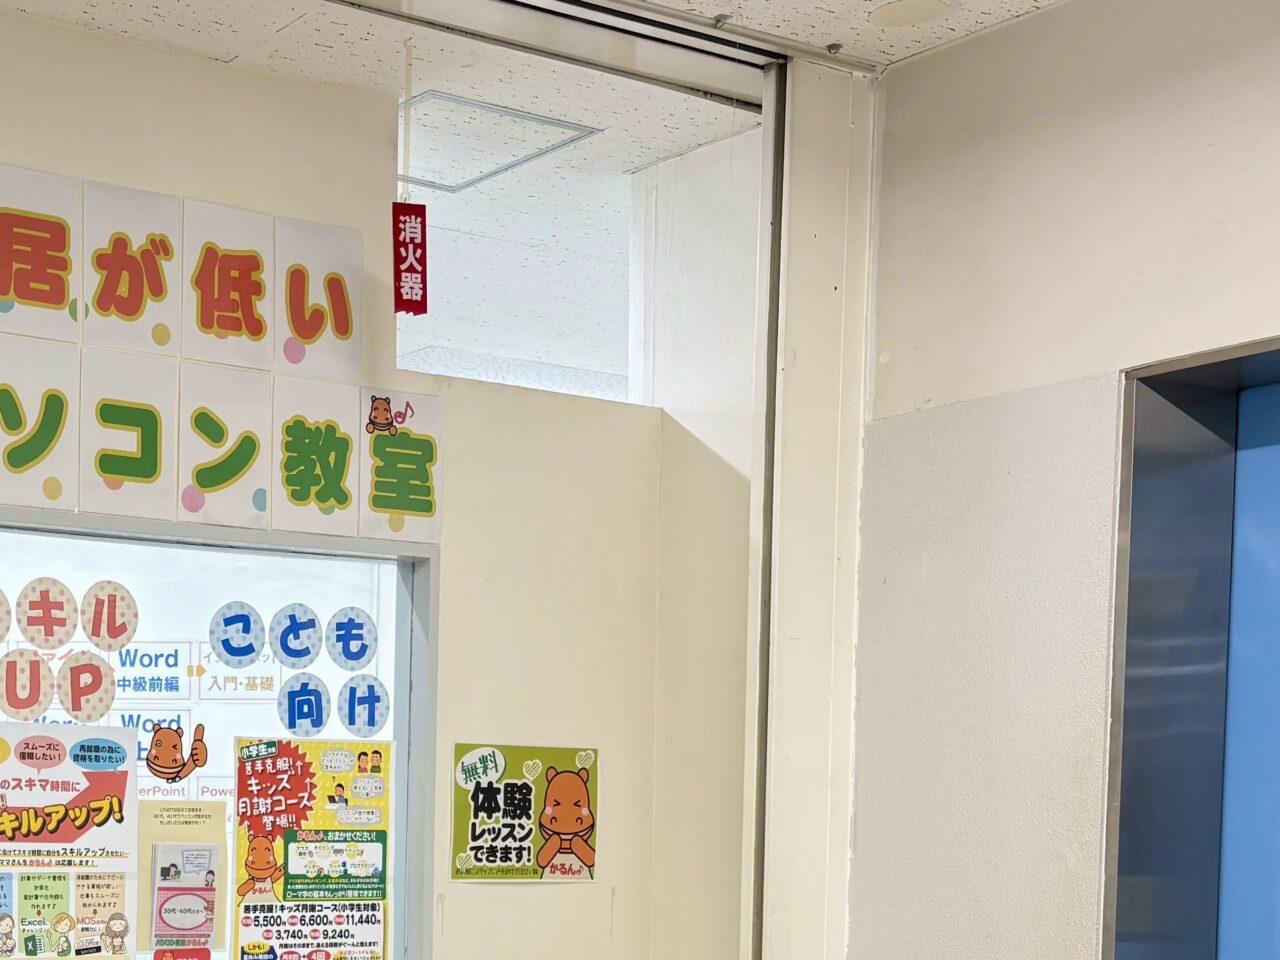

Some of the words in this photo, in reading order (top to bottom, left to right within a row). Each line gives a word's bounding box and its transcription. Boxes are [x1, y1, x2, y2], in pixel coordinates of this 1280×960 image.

[398, 214, 425, 302] 消火器
[119, 648, 178, 668] Word
[5, 660, 103, 712] UP
[117, 676, 180, 693] 中級前編
[208, 675, 274, 692] 入門・基礎
[288, 682, 380, 729] 向け
[23, 743, 59, 751] スムーズに
[461, 750, 498, 785] 無料
[247, 771, 295, 795] キッズ
[239, 792, 311, 816] 月謝コース
[471, 781, 532, 820] 体験
[471, 822, 533, 842] レッスン
[470, 846, 531, 863] できます!
[312, 951, 326, 960] 4回
